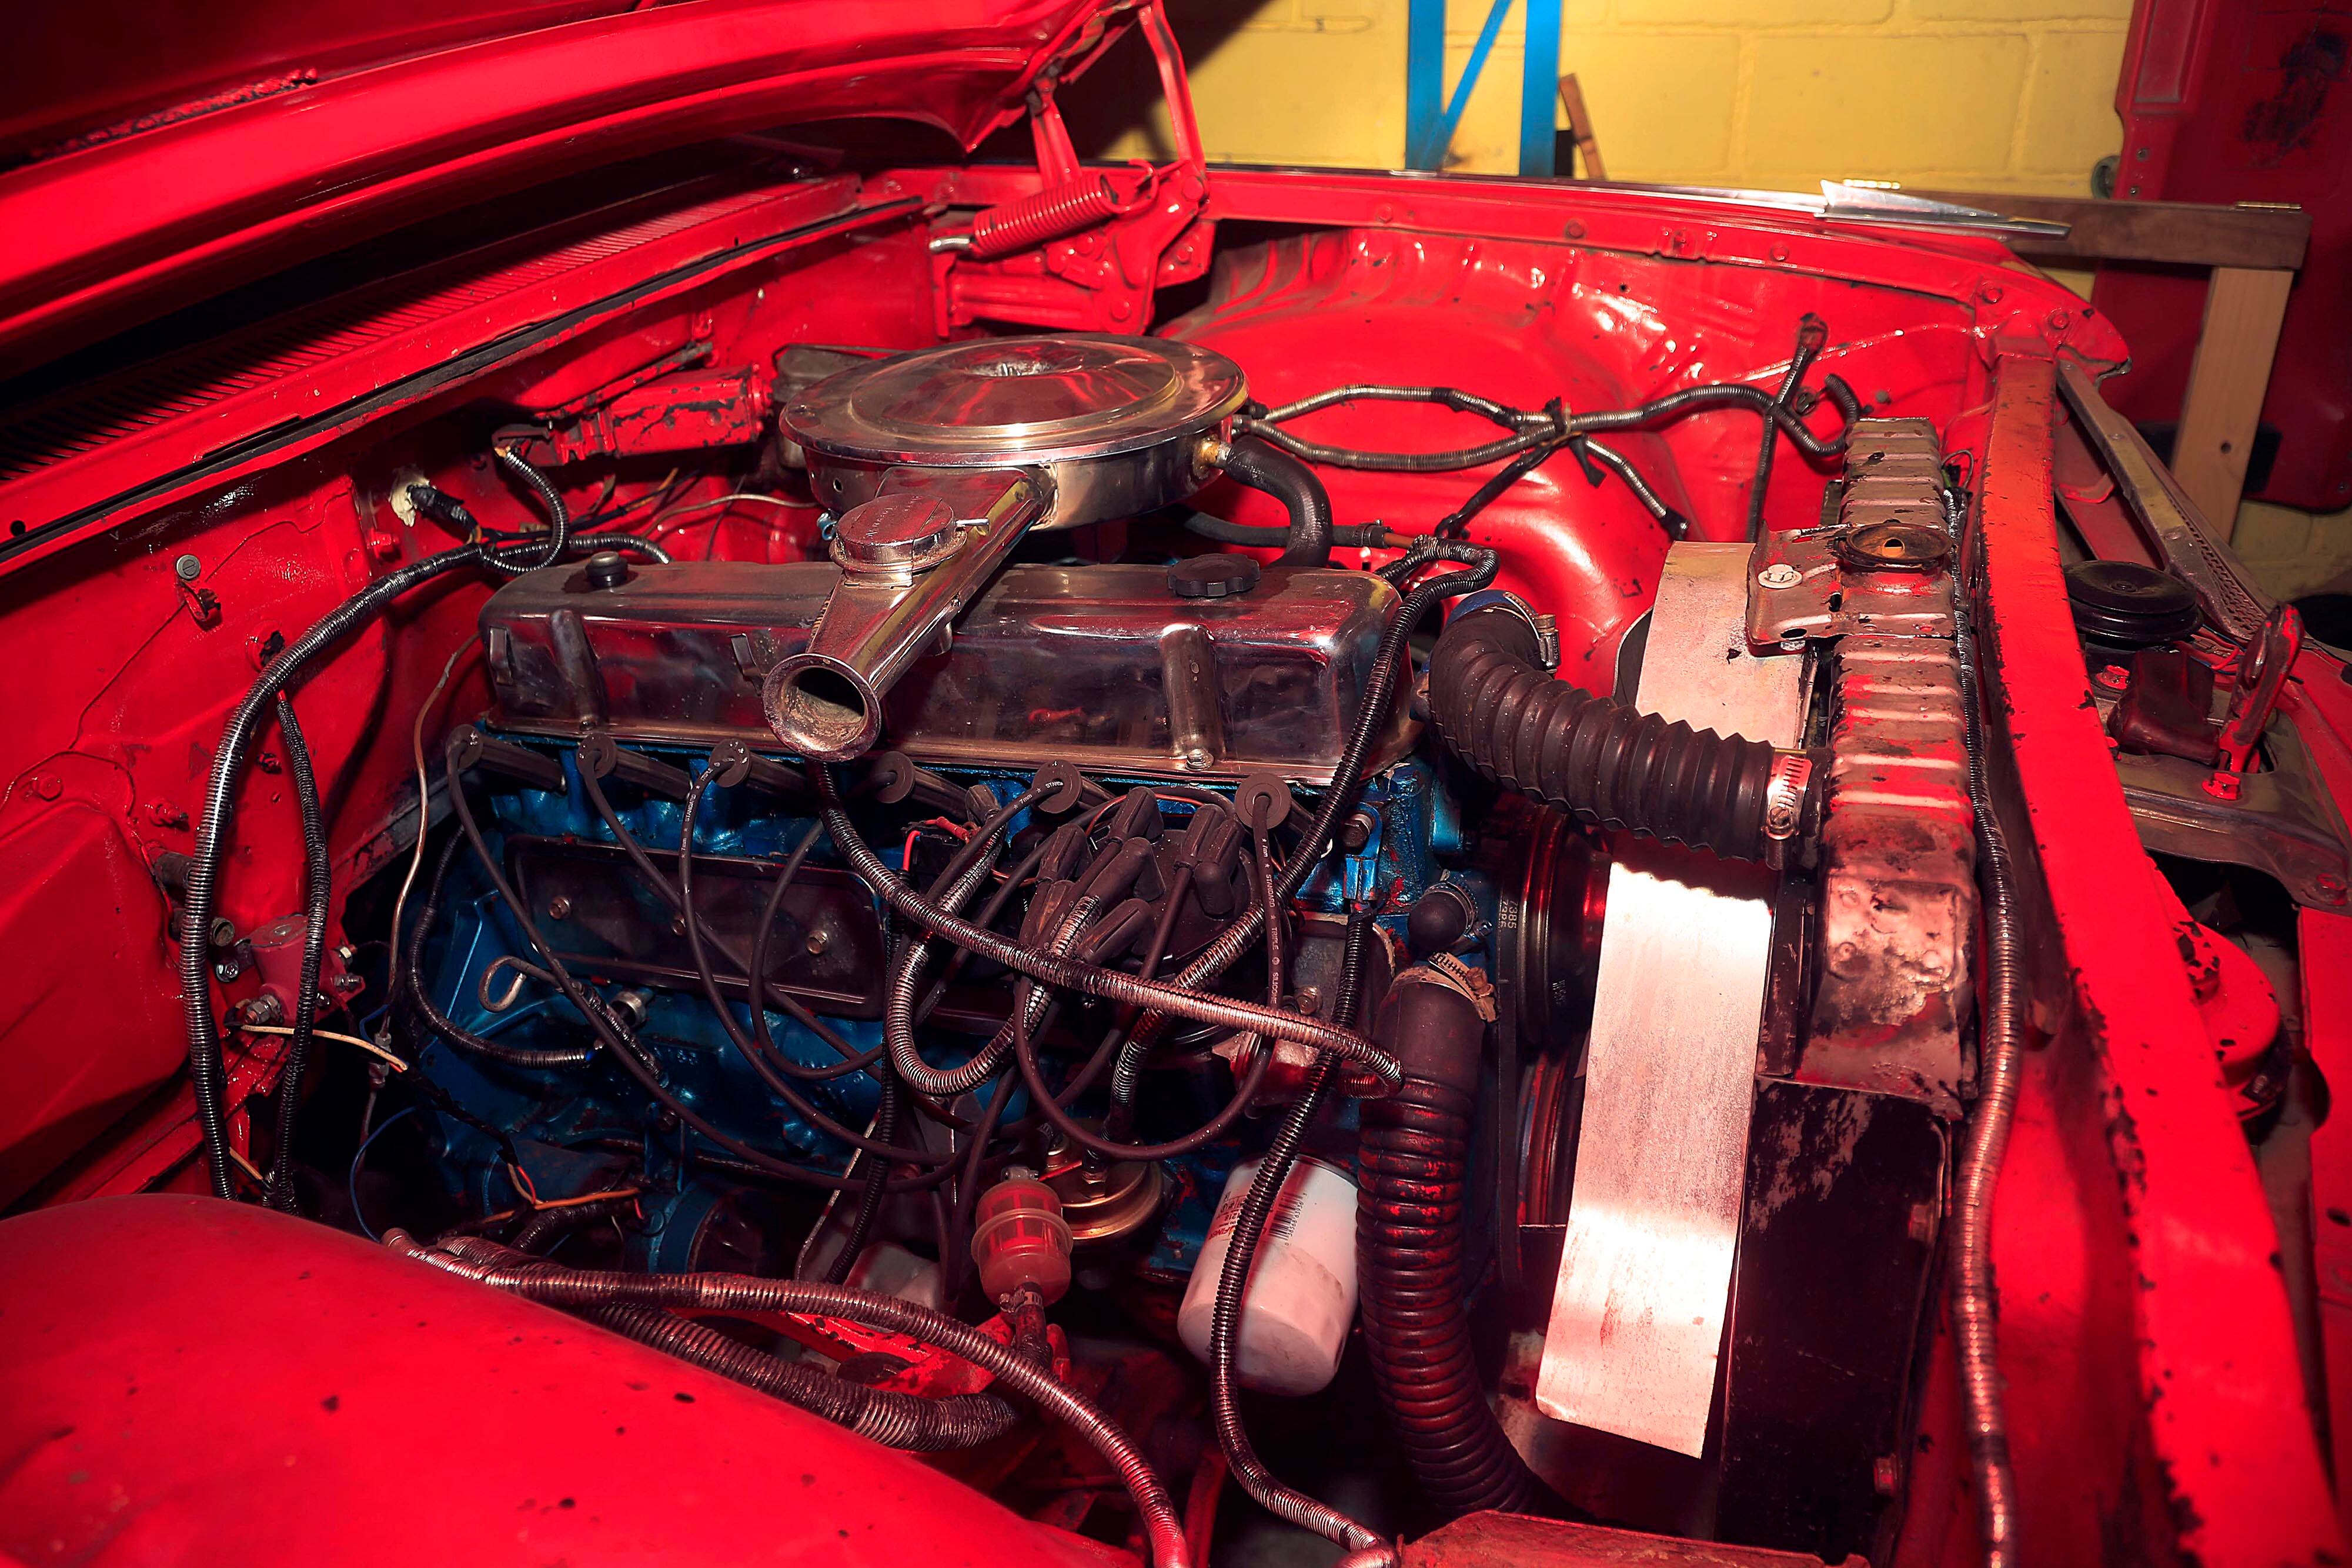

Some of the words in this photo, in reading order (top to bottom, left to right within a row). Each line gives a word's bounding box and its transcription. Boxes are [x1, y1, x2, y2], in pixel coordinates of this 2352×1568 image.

[684, 794, 696, 822] STANDARD
[1019, 794, 1033, 804] 7mm
[1265, 874, 1275, 908] STANDARD
[1270, 972, 1279, 1004] SILICONE
